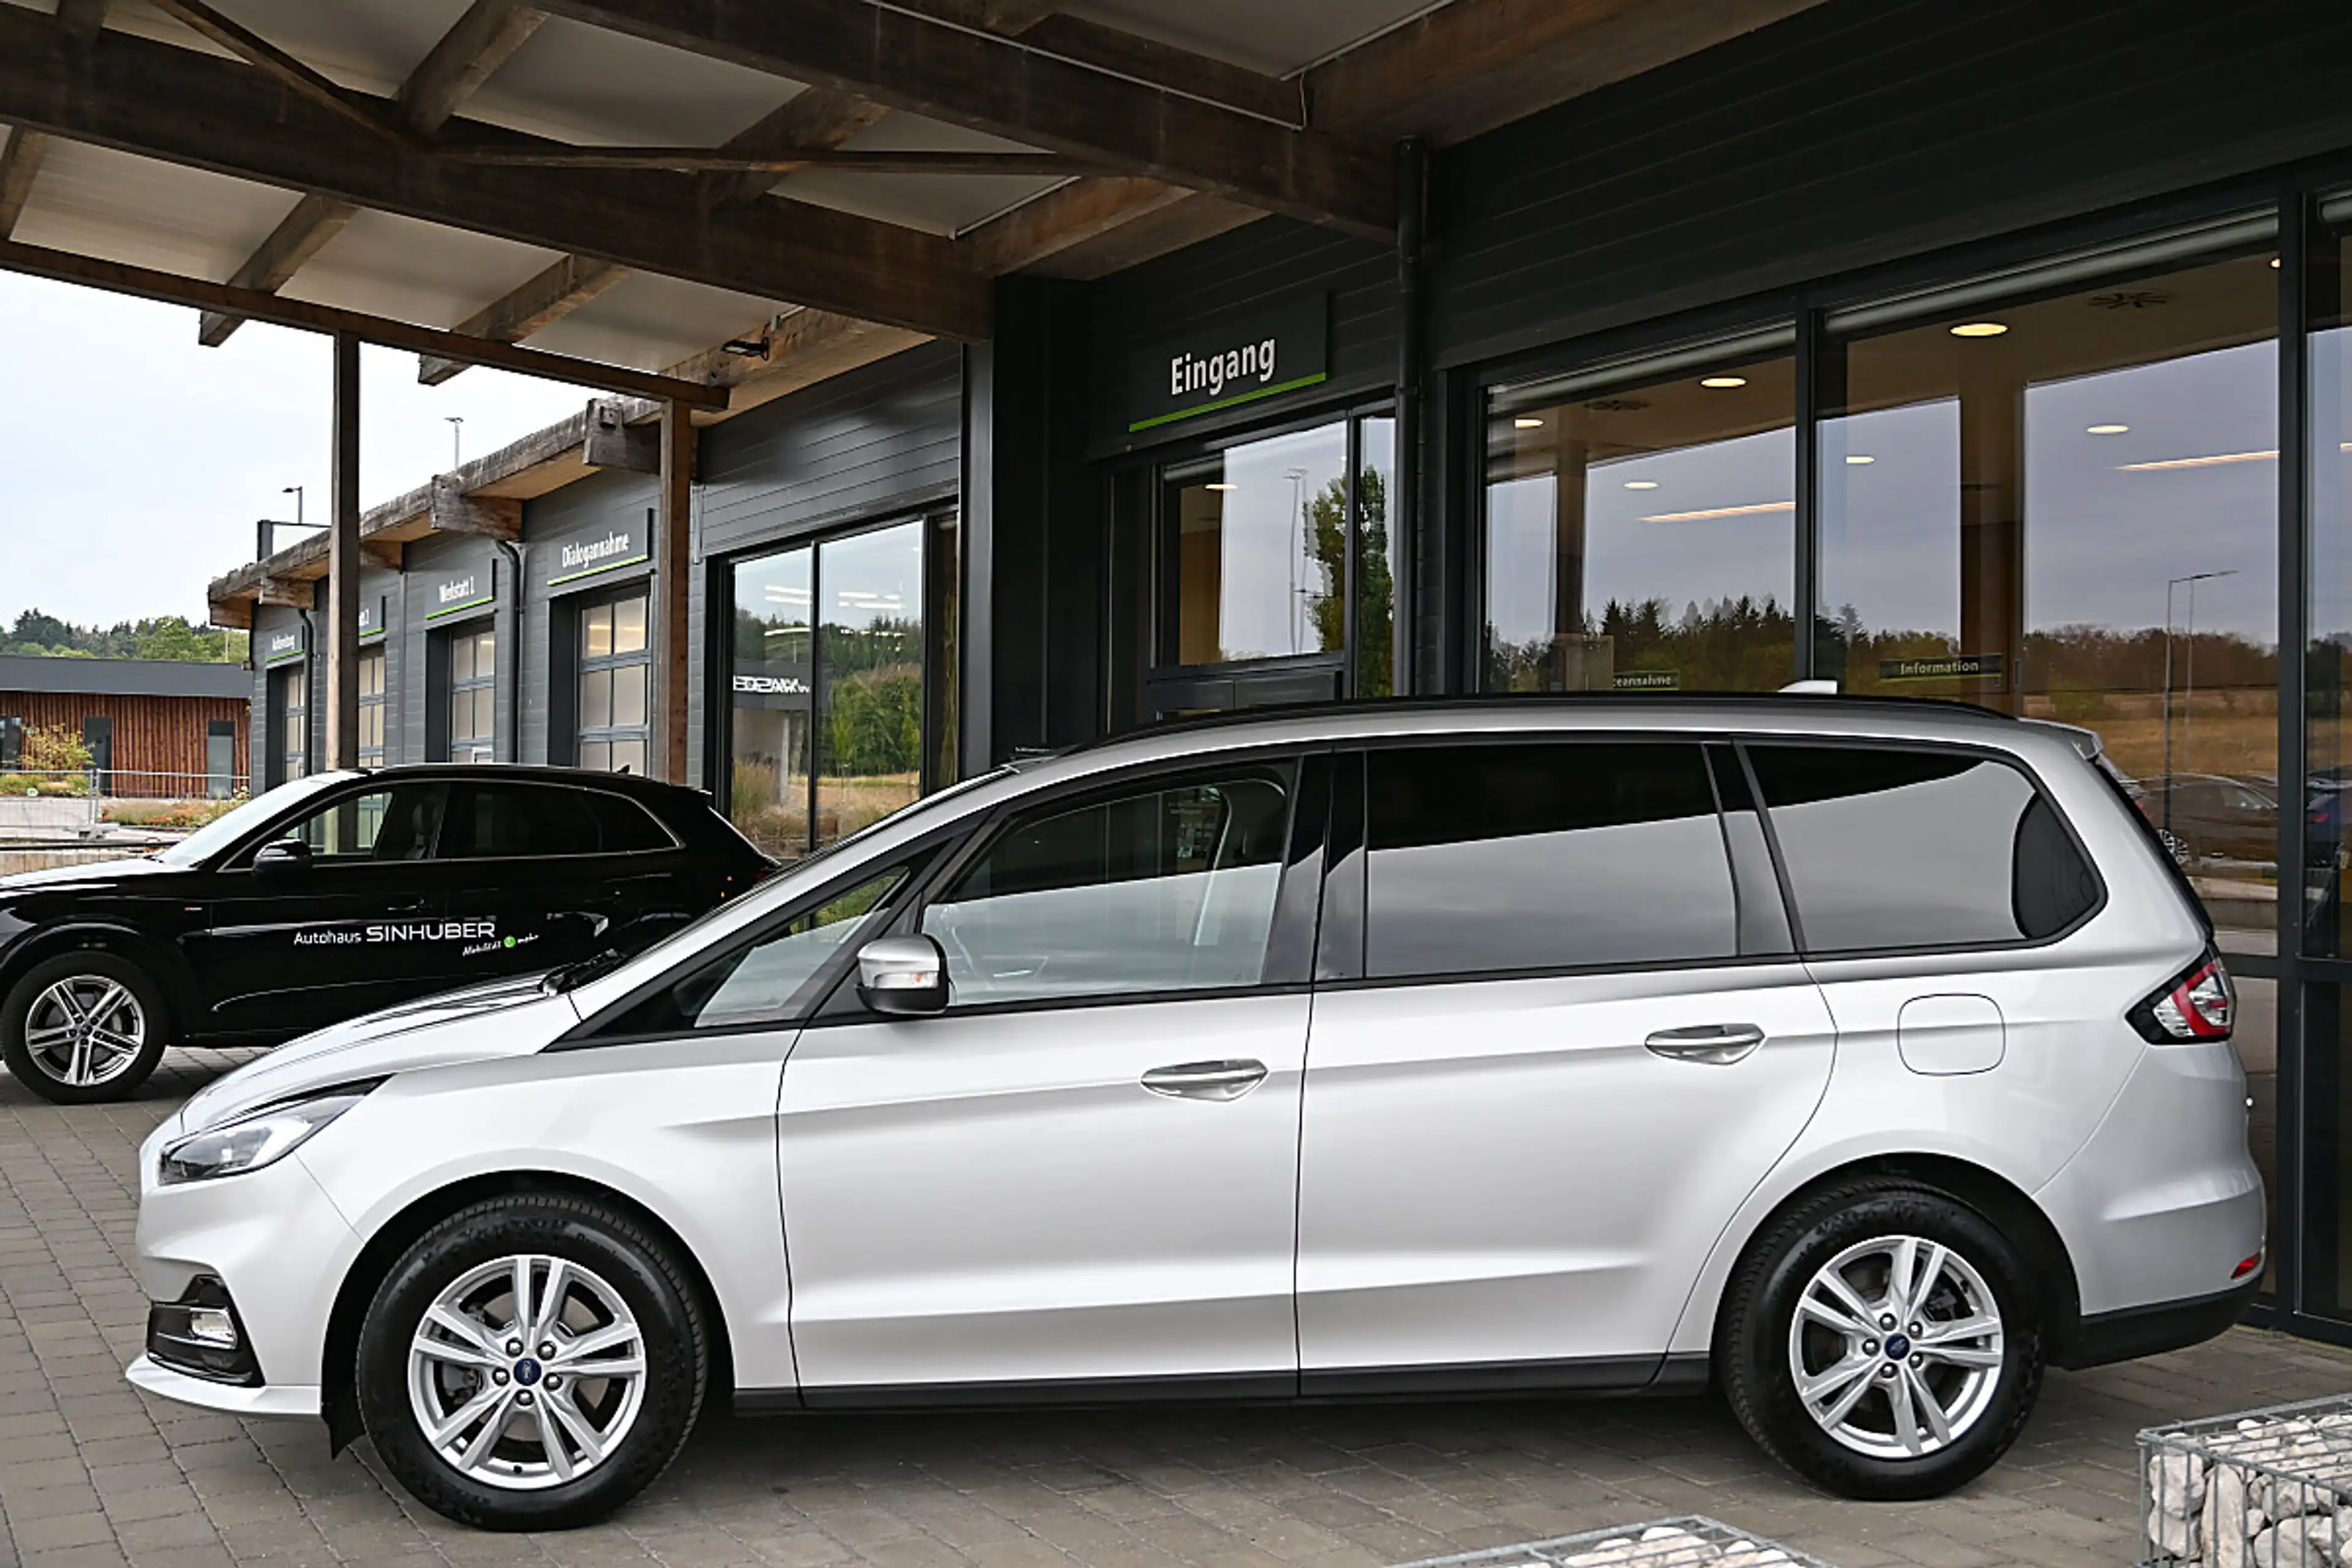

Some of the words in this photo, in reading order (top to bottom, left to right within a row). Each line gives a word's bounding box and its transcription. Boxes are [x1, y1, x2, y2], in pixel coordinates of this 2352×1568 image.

[1171, 339, 1276, 396] Eingang
[1901, 661, 1979, 674] Information
[293, 930, 362, 945] Autohaus
[366, 922, 496, 942] SINHUBER
